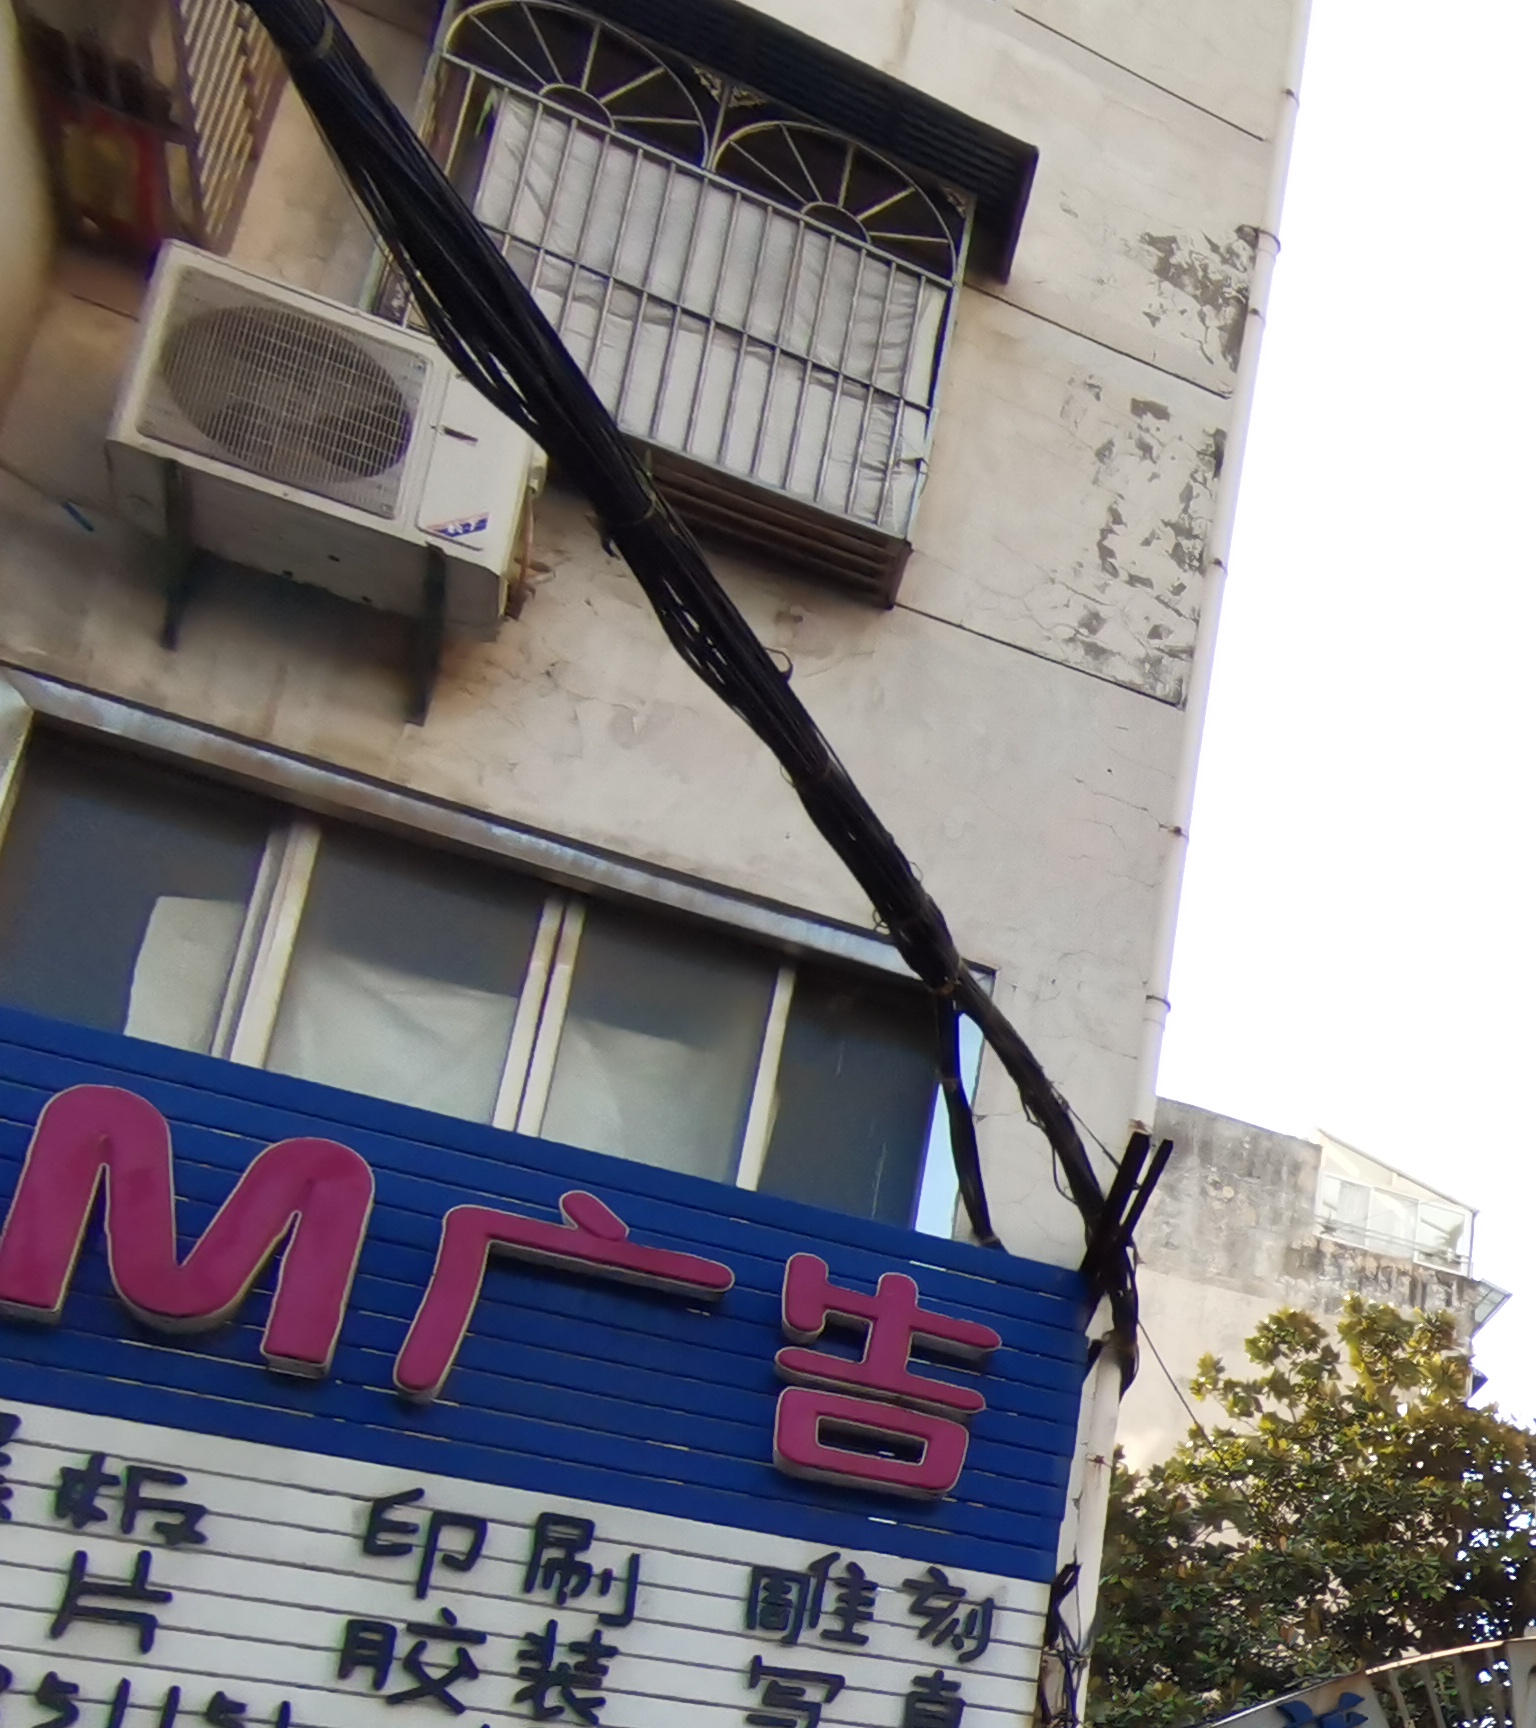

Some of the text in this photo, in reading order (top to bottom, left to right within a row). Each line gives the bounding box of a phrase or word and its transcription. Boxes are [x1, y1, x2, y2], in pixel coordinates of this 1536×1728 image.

[362, 1487, 641, 1628] 印刷
[745, 1551, 996, 1663] 雕刻
[337, 1606, 620, 1727] 胶装
